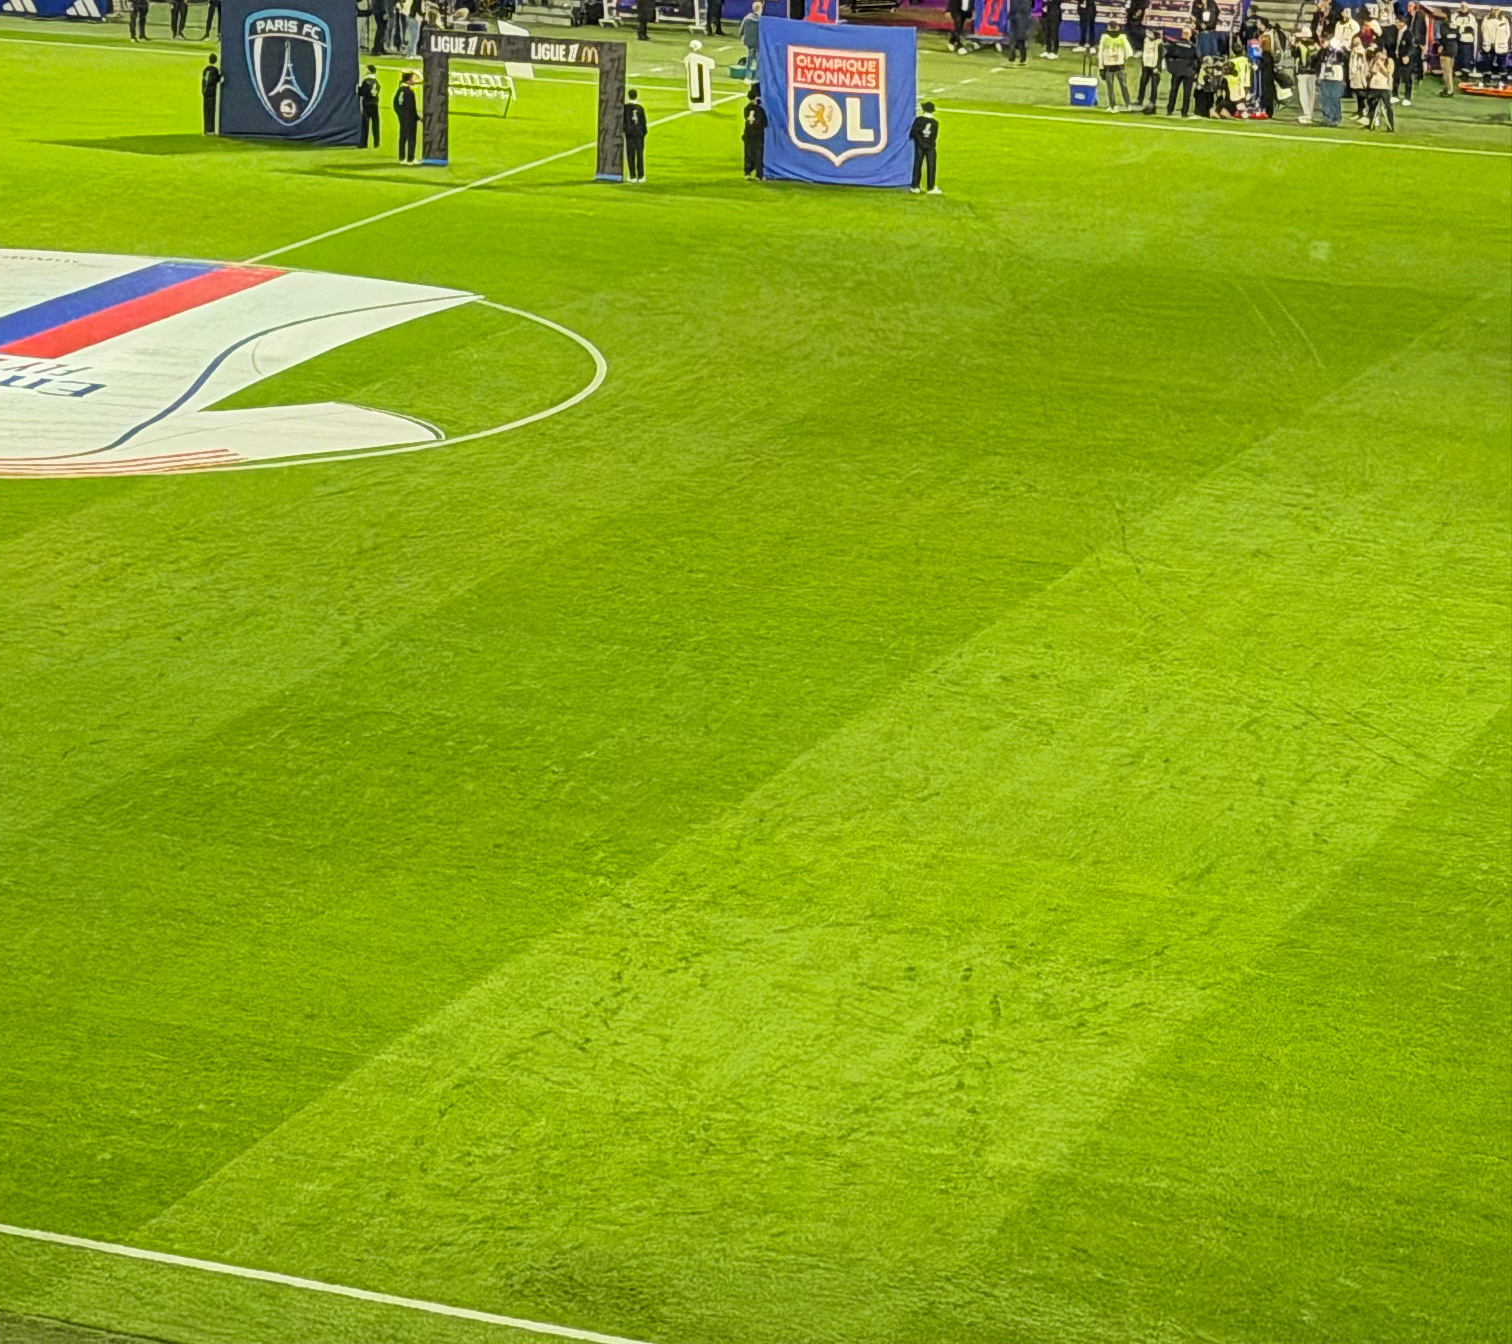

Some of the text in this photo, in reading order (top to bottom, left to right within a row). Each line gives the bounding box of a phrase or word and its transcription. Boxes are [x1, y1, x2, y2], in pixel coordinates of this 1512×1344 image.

[256, 19, 322, 40] PARIS FC
[430, 35, 466, 54] LIGUE
[531, 42, 567, 61] LIGUE
[796, 55, 877, 73] OLYMPIQUE
[796, 68, 877, 87] LYONNAIS
[798, 93, 875, 142] OL
